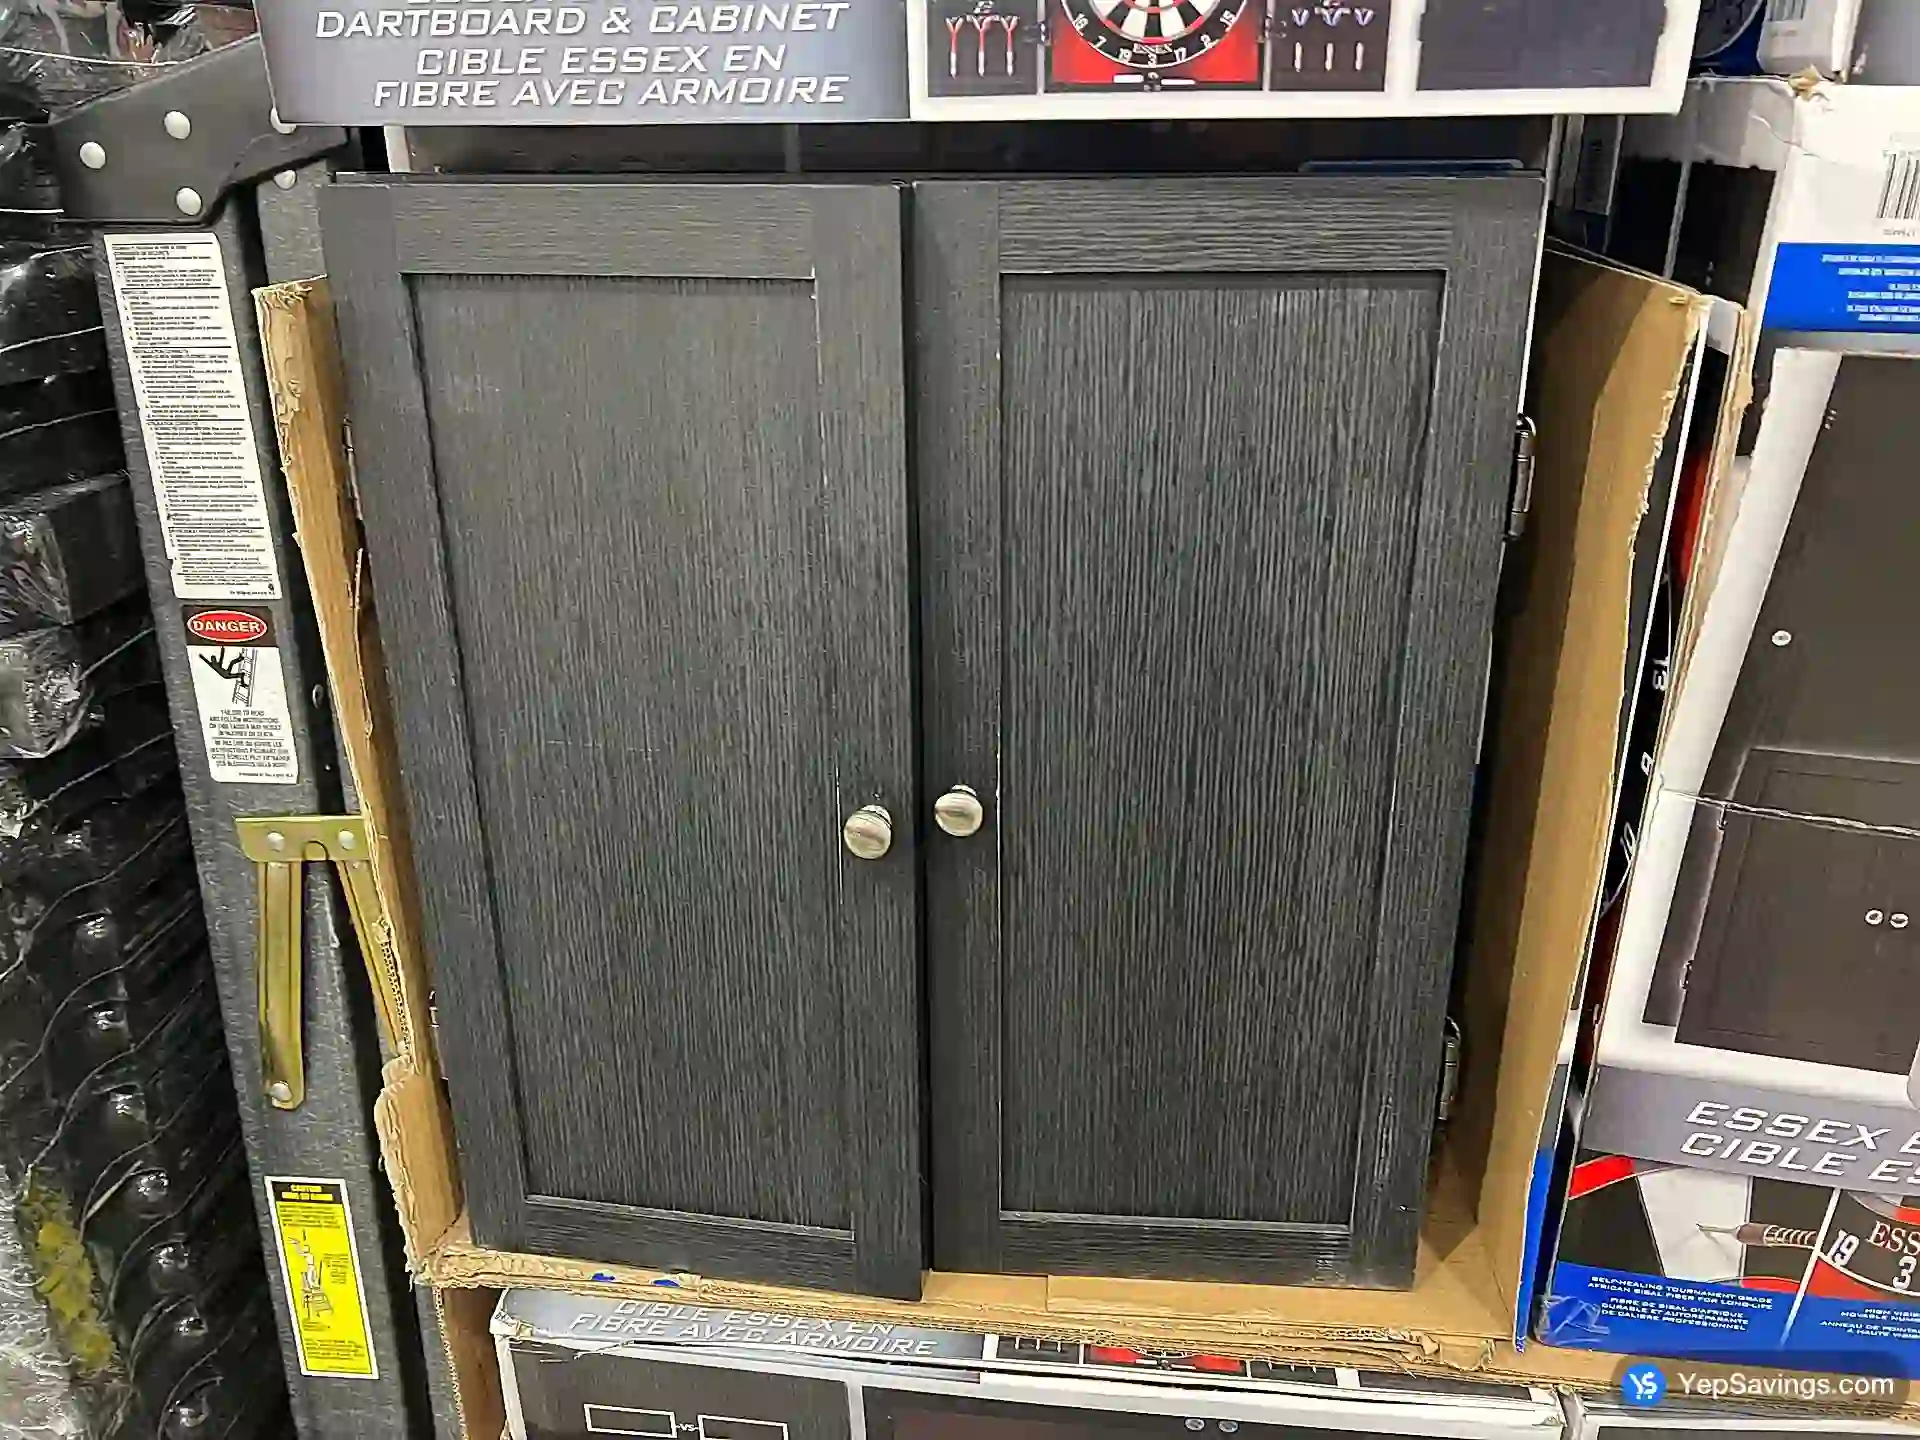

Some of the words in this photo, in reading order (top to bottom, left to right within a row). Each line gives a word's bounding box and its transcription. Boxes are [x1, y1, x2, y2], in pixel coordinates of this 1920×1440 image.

[316, 7, 587, 38] DARTBOARD
[601, 6, 632, 34] &
[649, 2, 850, 33] CABINET
[416, 47, 546, 75] CIBLE
[560, 45, 709, 73] ESSEX
[723, 44, 786, 72] EN
[1147, 53, 1158, 67] 3
[373, 79, 500, 107] FIBRE
[511, 78, 626, 106] AVEC
[637, 76, 851, 105] ARMOIRE
[191, 620, 262, 633] DANGER
[1684, 1100, 1893, 1151] ESSEX
[1680, 1132, 1857, 1177] CIBLE
[1827, 1229, 1860, 1267] 19
[1892, 1255, 1917, 1290] 3
[1666, 1286, 1737, 1300] TOURNAMENT
[1698, 1296, 1718, 1304] FOR
[615, 1299, 709, 1322] CIBLE
[724, 1310, 834, 1333] ESSEX
[569, 1313, 672, 1335] FIBRE
[677, 1324, 768, 1342] AVEC
[774, 1331, 938, 1356] ARMOIRE
